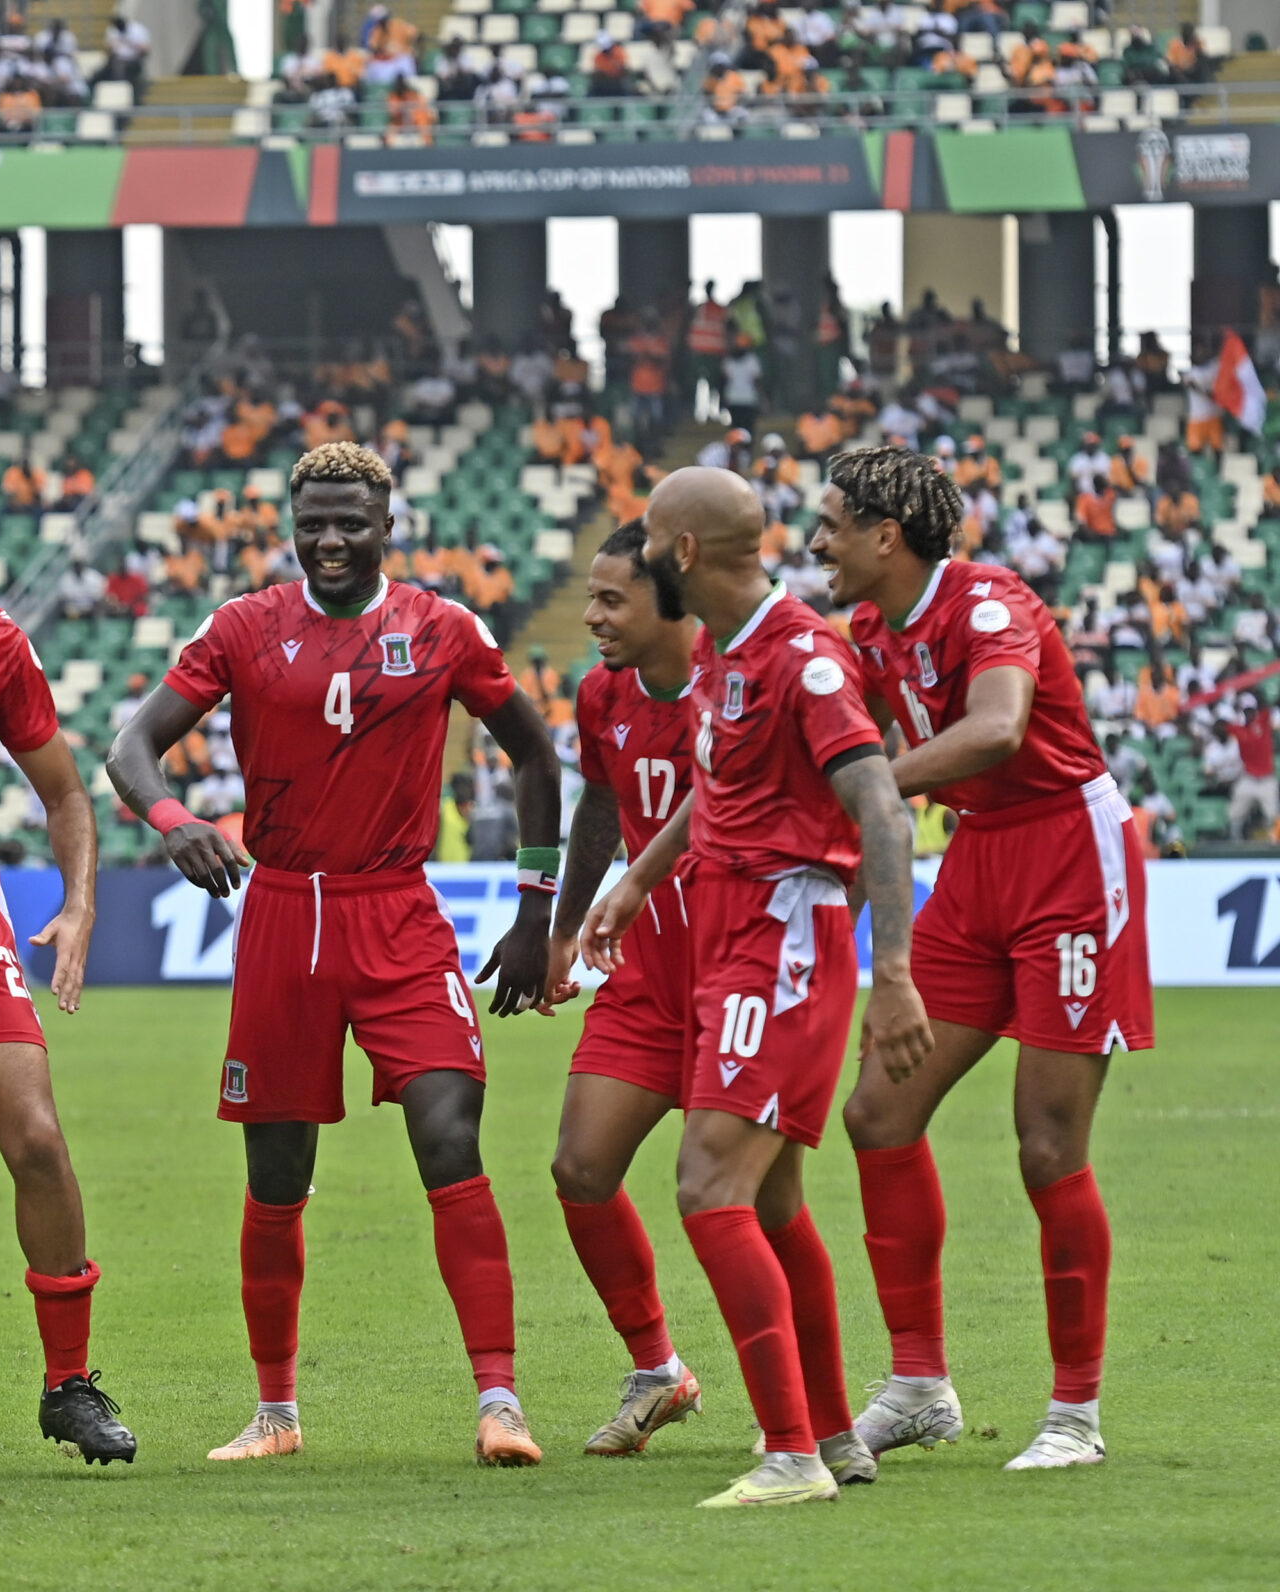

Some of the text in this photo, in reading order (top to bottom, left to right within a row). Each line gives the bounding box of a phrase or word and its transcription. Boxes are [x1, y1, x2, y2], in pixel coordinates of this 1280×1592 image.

[605, 164, 691, 189] NATIONS
[324, 672, 354, 734] 4
[634, 757, 676, 820] 17
[1055, 932, 1098, 997] 16
[444, 971, 475, 1027] 4
[719, 992, 768, 1058] 10
